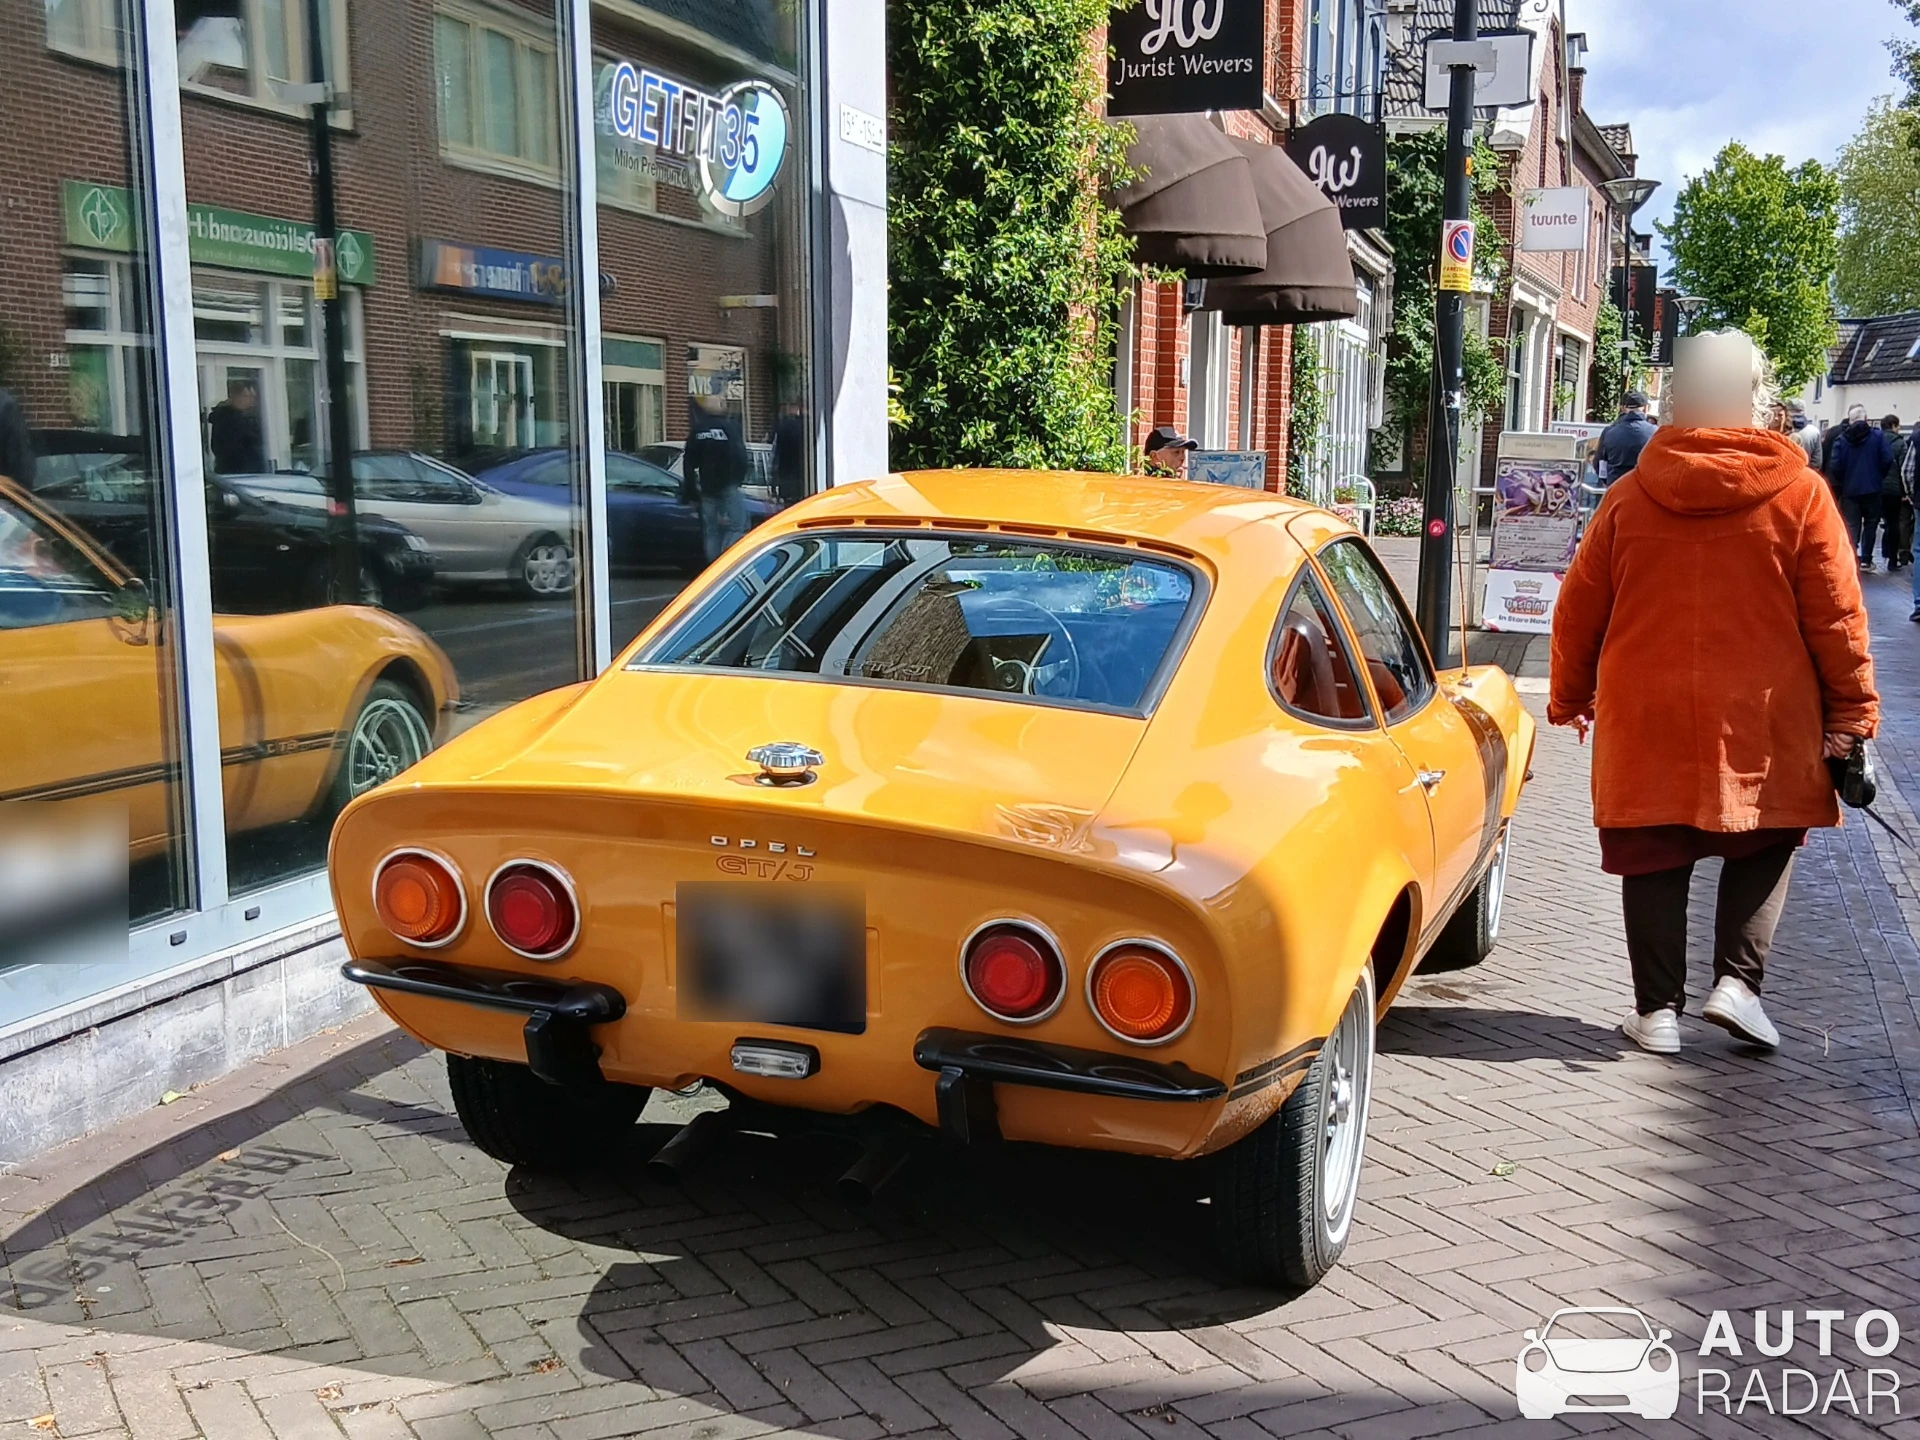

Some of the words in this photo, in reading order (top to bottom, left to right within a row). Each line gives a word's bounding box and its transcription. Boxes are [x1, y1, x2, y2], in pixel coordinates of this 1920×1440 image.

[1115, 56, 1176, 86] Jurist
[1180, 53, 1253, 75] Wevers
[614, 147, 640, 171] Milon
[1332, 194, 1379, 208] Wevers
[1530, 212, 1578, 226] tuunte
[1508, 615, 1529, 624] Store
[711, 835, 817, 857] OPEL
[715, 854, 815, 882] GT/J
